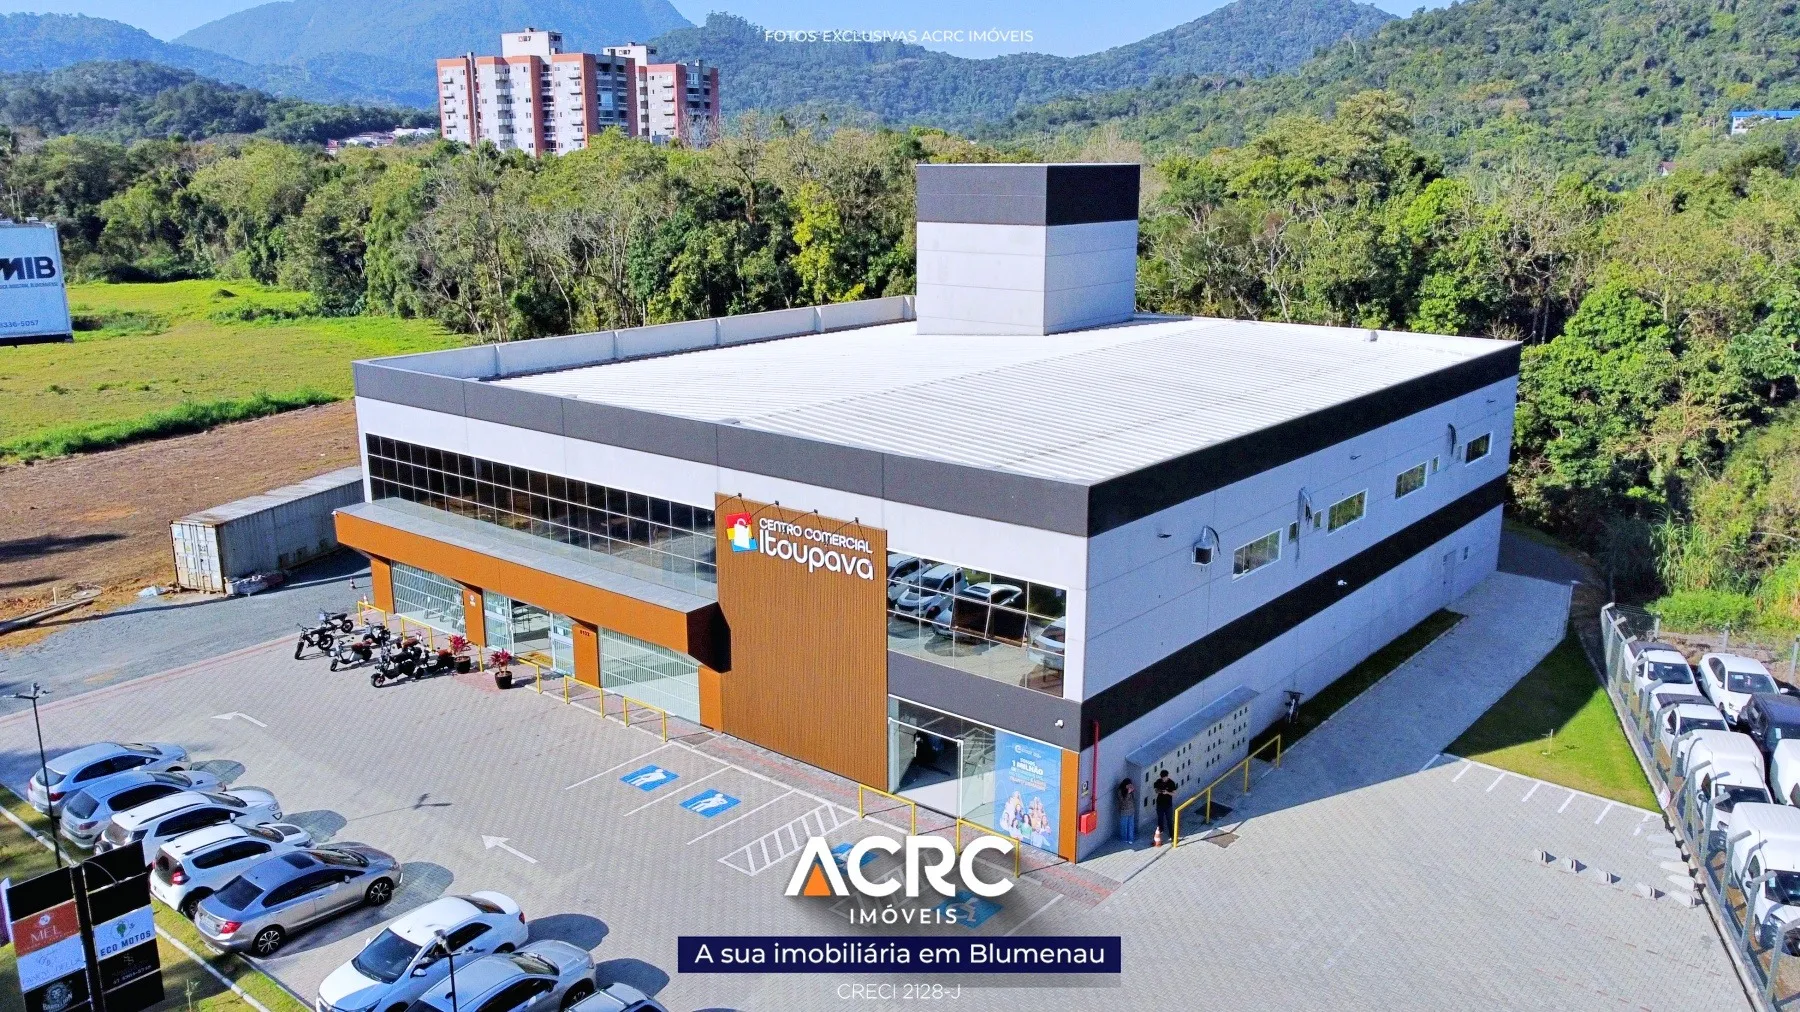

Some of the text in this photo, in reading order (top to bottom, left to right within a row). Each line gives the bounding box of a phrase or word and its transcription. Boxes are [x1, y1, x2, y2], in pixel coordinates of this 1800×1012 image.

[759, 518, 874, 554] CENTRO COMERCIAL
[759, 530, 874, 580] Itoupava
[100, 930, 151, 957] ECO MOTOS
